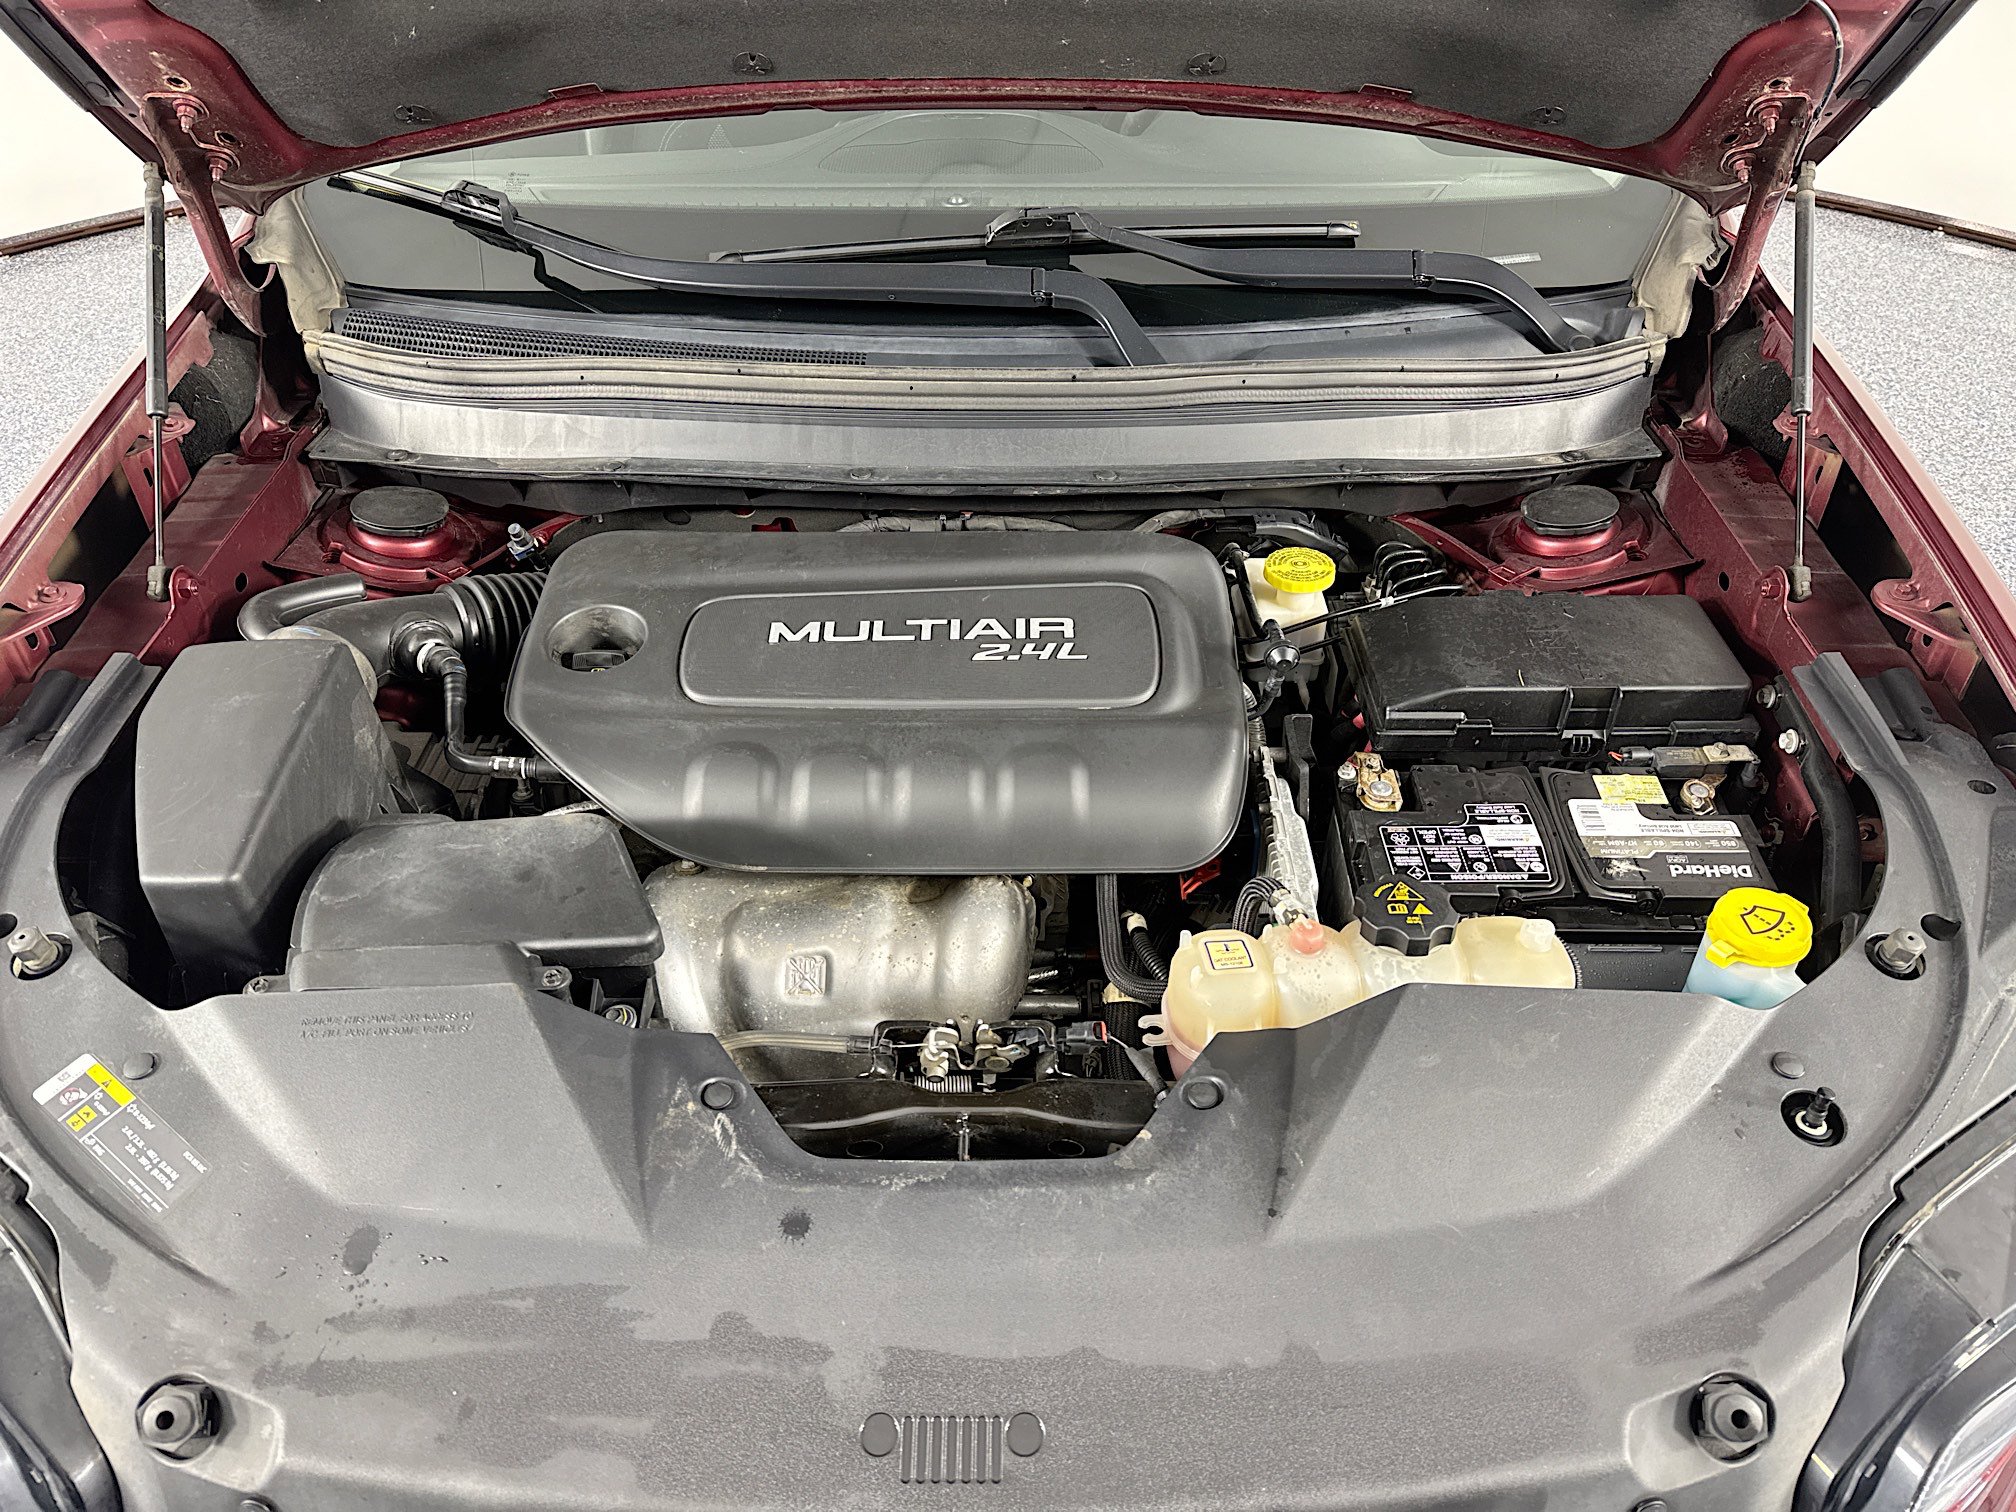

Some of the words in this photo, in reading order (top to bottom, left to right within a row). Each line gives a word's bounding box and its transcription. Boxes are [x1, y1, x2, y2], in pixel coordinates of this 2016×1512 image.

[768, 617, 1075, 644] MULTIAIR
[971, 642, 1089, 661] 2.4L
[1669, 864, 1753, 878] DieHard
